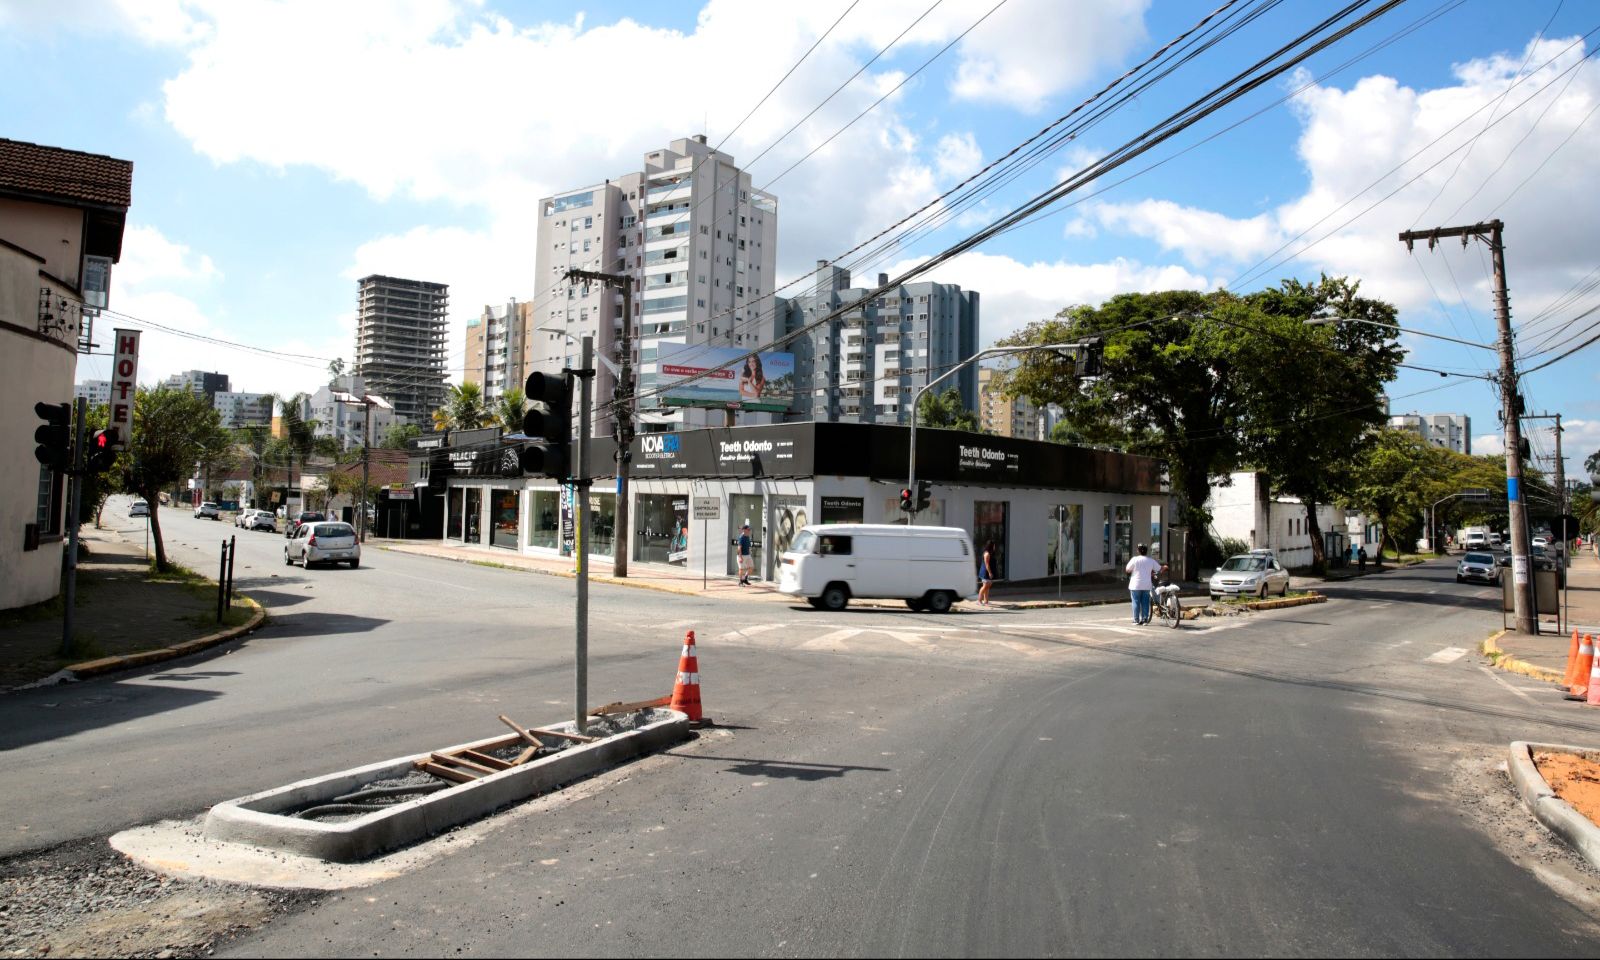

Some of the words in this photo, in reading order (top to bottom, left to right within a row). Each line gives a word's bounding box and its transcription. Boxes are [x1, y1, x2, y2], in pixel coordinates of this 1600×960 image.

[720, 441, 741, 452] Teeth
[743, 440, 772, 452] Odonto
[959, 445, 980, 458] Teeth
[982, 448, 1005, 461] Odonto
